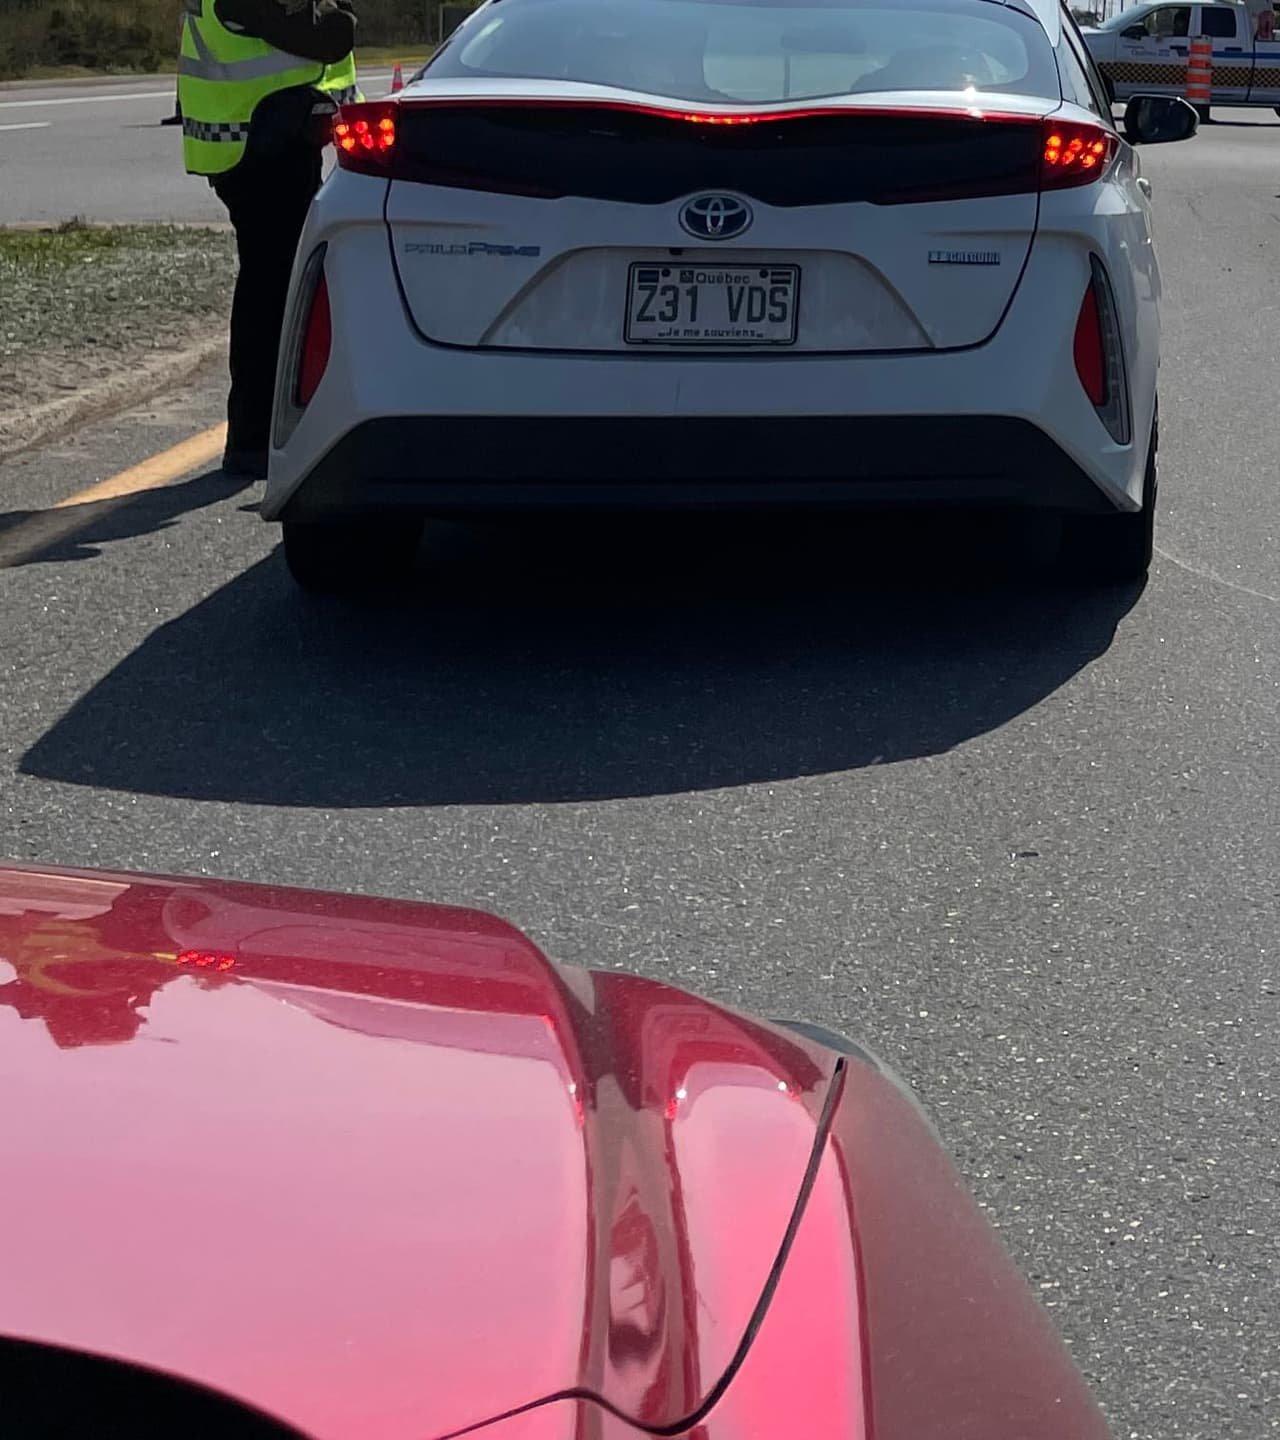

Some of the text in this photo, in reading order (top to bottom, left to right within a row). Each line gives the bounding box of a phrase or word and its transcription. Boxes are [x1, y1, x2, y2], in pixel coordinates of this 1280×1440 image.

[696, 272, 751, 284] Québec
[636, 284, 789, 323] Z31 VDS
[684, 329, 700, 337] me
